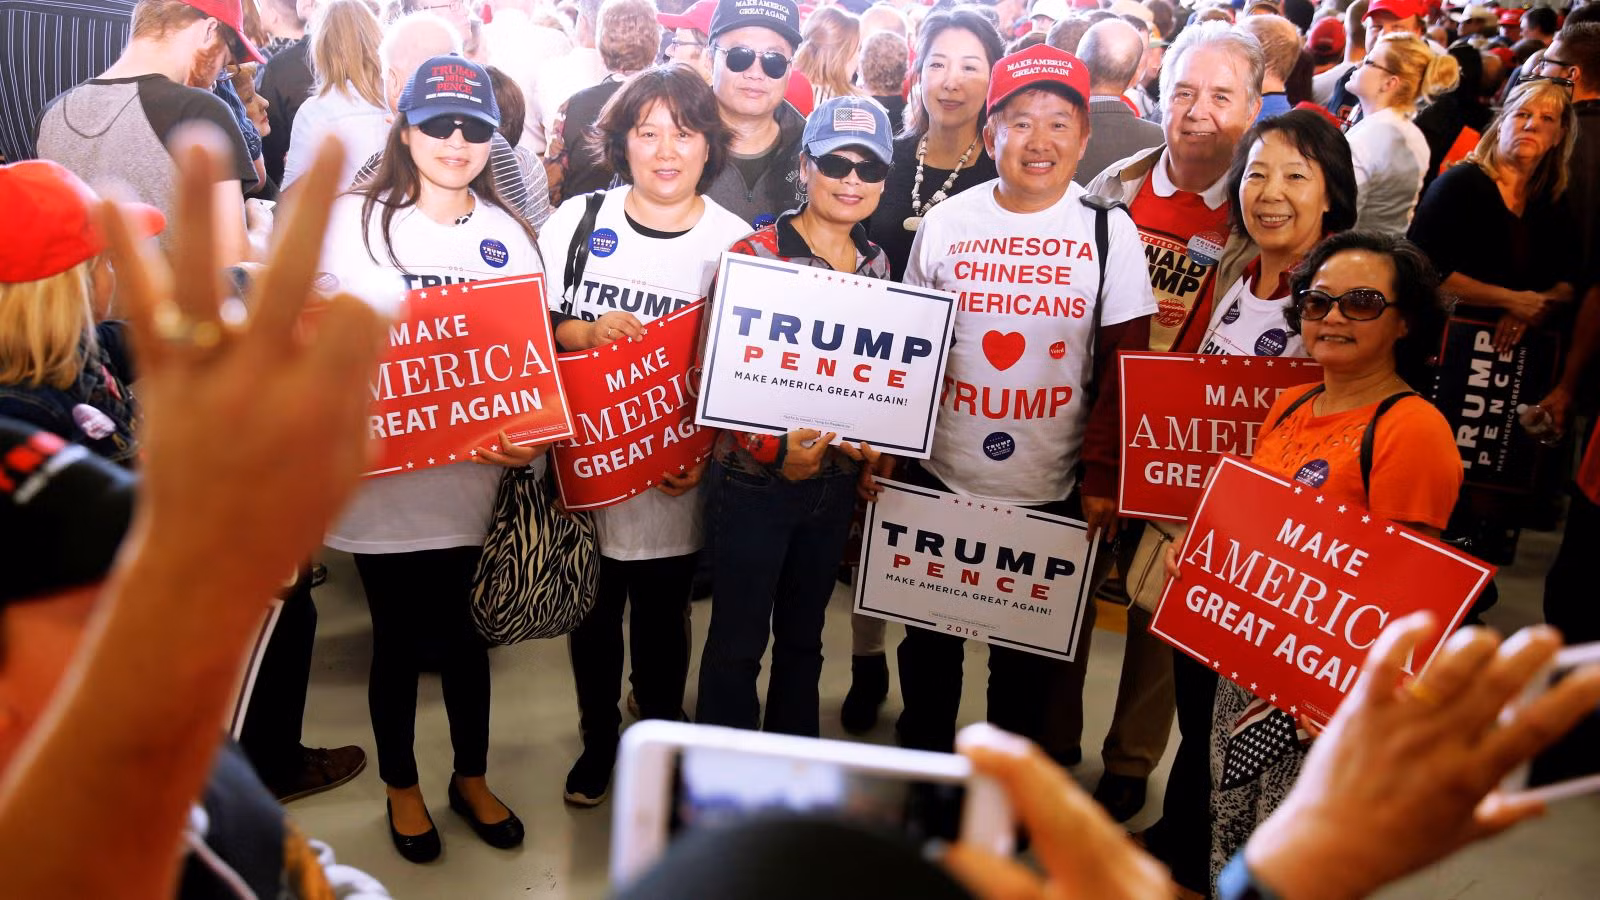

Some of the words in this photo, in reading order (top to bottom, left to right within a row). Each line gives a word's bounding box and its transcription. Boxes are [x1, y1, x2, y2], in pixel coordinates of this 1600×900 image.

[759, 0, 790, 15] AMERICA
[765, 9, 787, 22] AGAIN
[431, 64, 477, 78] TRUMP
[1007, 59, 1032, 71] MAKE
[1033, 59, 1073, 69] AMERICA
[1012, 67, 1041, 78] GREAT
[1041, 67, 1069, 76] AGAIN
[436, 82, 473, 95] PENCE
[482, 246, 506, 256] TRUMP
[592, 237, 616, 245] TRUMP
[947, 237, 1094, 261] MINNESOTA
[954, 261, 1072, 286] CHINESE
[1145, 244, 1206, 278] NALD
[953, 291, 1087, 319] MERICANS
[389, 314, 469, 347] MAKE
[732, 305, 932, 364] TRUMP
[1261, 336, 1283, 349] TRUMP
[369, 339, 551, 402] MERICA
[605, 346, 670, 393] MAKE
[743, 345, 907, 389] PENCE
[734, 371, 768, 384] MAKE
[771, 377, 823, 393] AMERICA
[827, 386, 864, 400] GREAT
[868, 393, 908, 406] AGAIN!
[369, 404, 439, 440] REAT
[450, 387, 543, 426] AGAIN
[556, 365, 702, 448] MERIC
[1478, 350, 1514, 466] PENCE
[1503, 407, 1515, 446] AMERICA
[1511, 378, 1521, 405] GREAT
[573, 434, 654, 479] GREAT
[986, 439, 1011, 450] TRUMP
[881, 521, 1075, 580] TRUMP
[1276, 518, 1370, 577] MAKE
[893, 553, 1050, 600] PENCE
[886, 572, 915, 586] MAKE
[919, 581, 968, 598] AMERICA
[972, 593, 1008, 606] GREAT
[1012, 602, 1052, 616] AGAIN!
[947, 624, 978, 637] 2016
[1185, 584, 1276, 647] GREAT
[1272, 633, 1358, 694] AGAI
